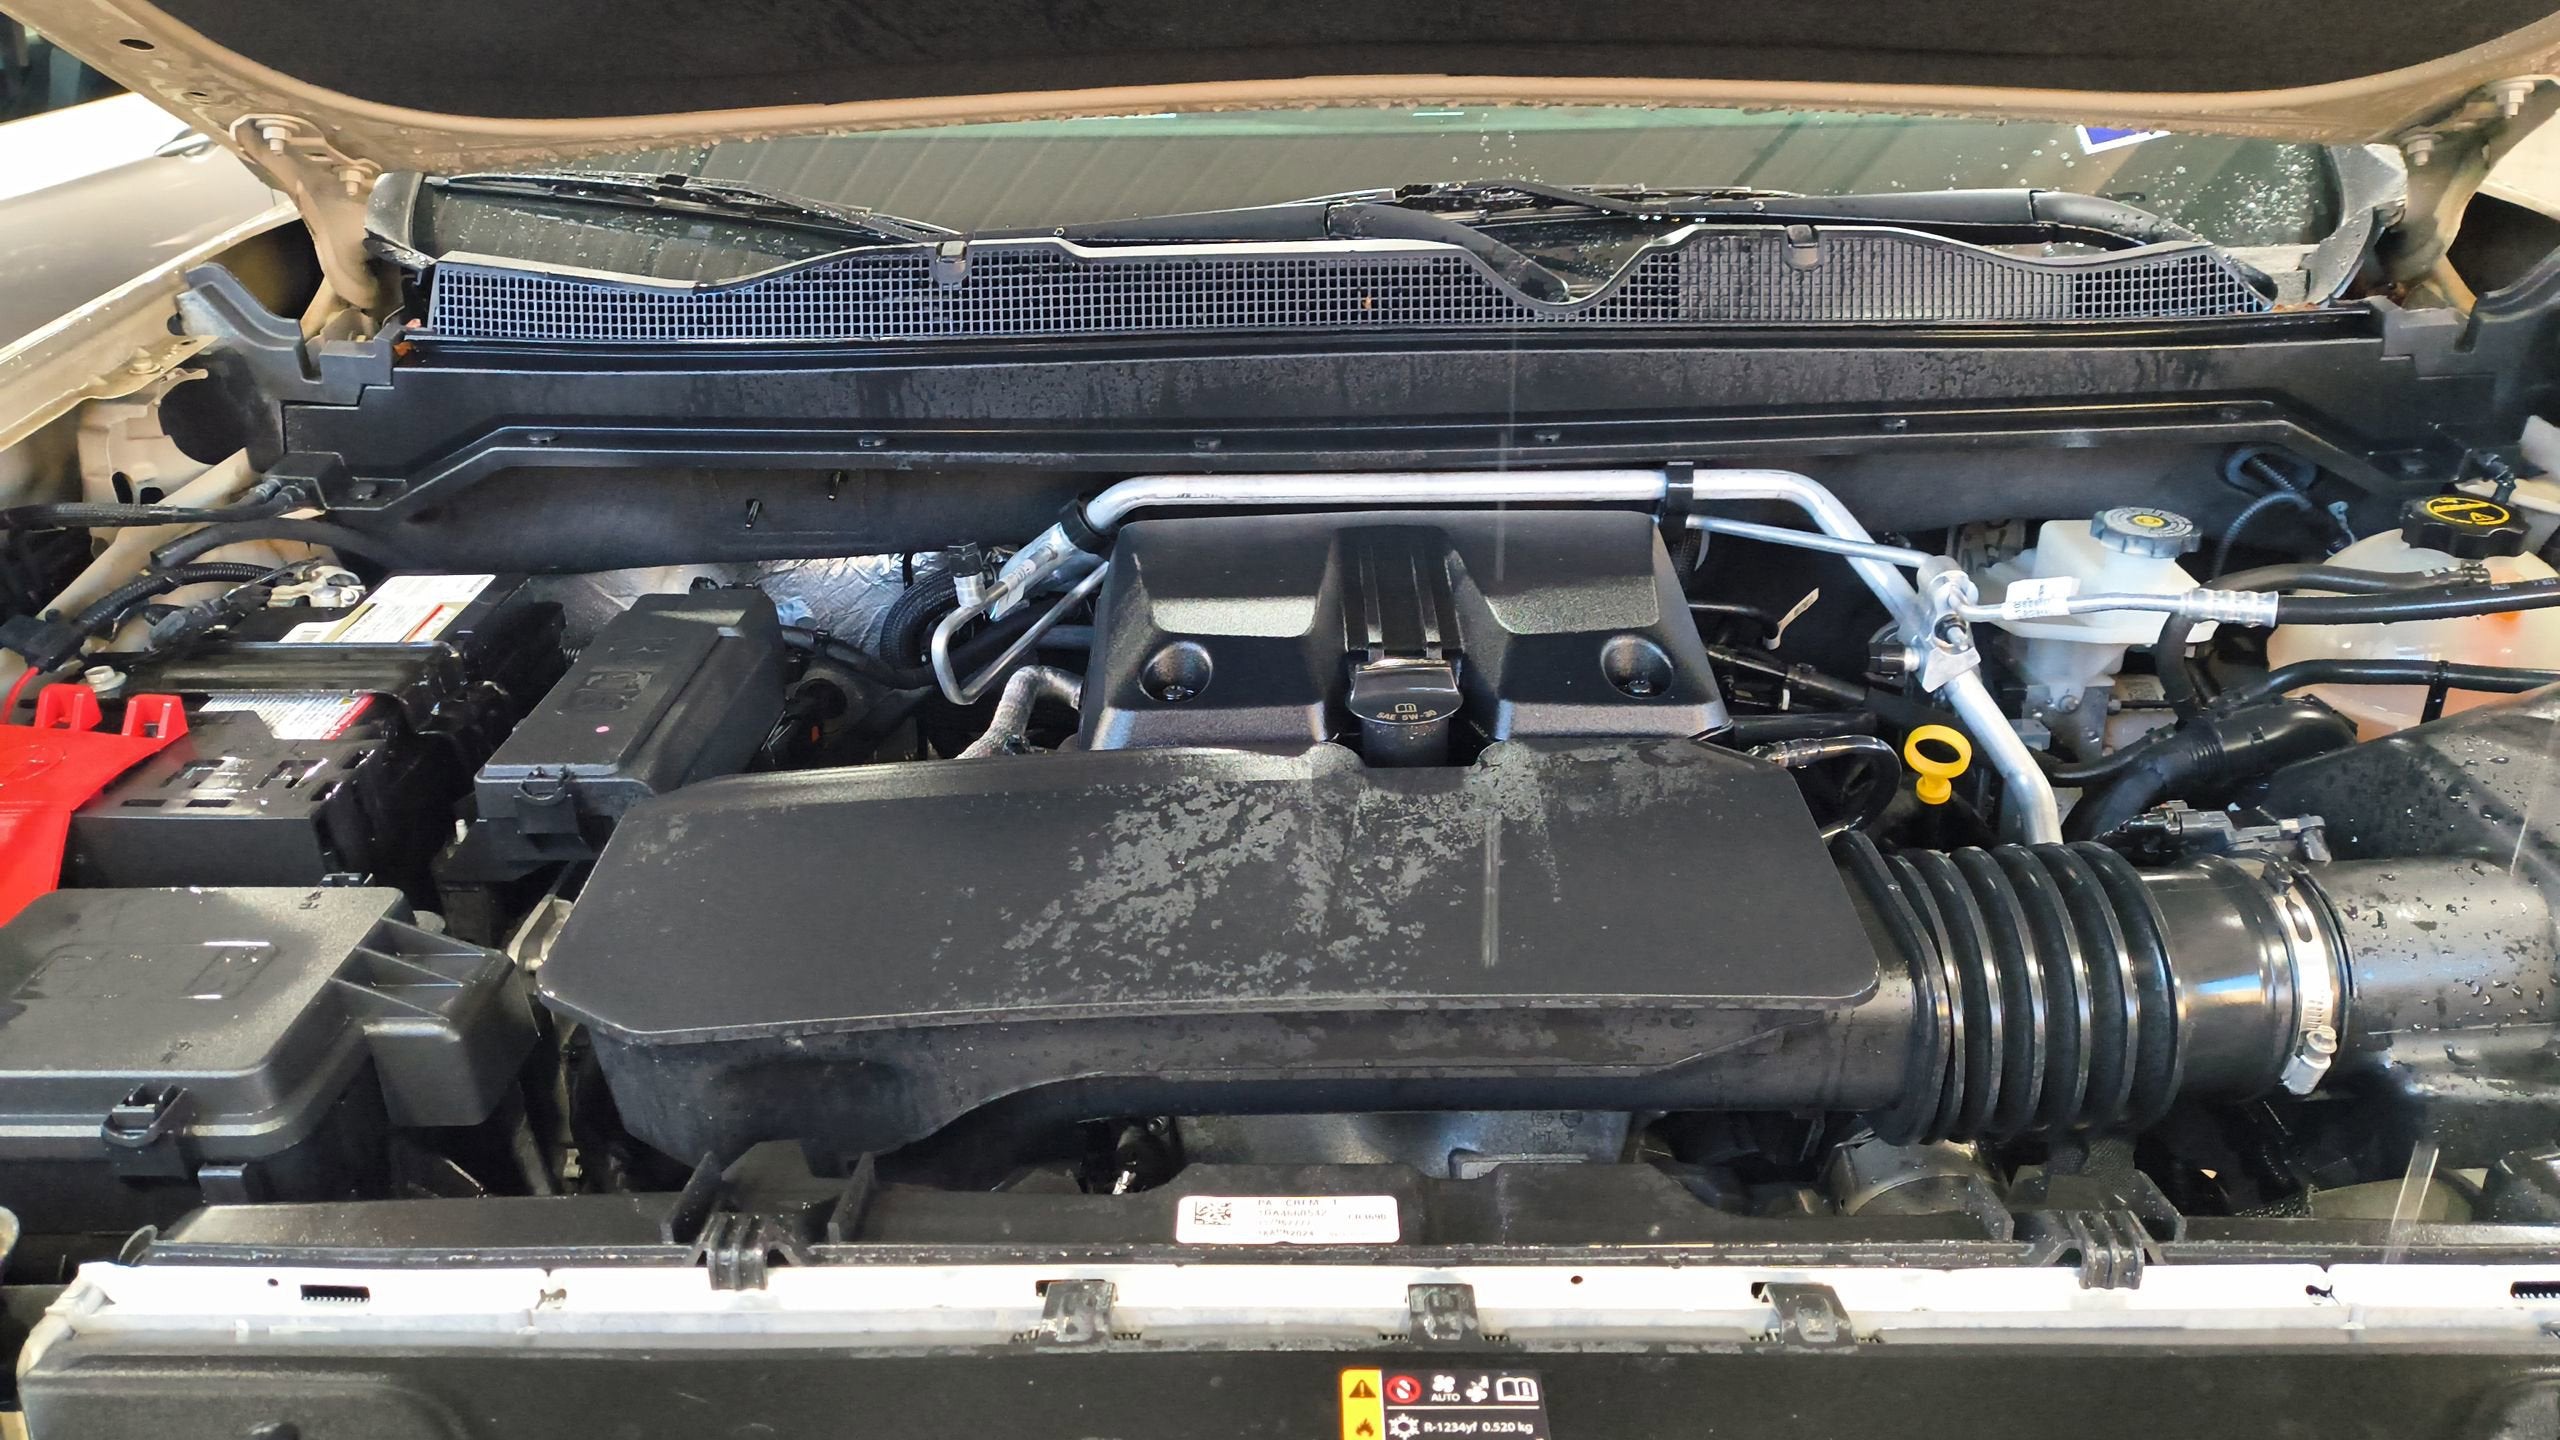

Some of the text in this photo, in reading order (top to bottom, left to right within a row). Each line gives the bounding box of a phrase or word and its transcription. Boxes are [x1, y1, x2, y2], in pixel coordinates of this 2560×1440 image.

[1430, 1393, 1461, 1402] AUTO
[1423, 1421, 1534, 1434] R-1234yf 0.520 kg
